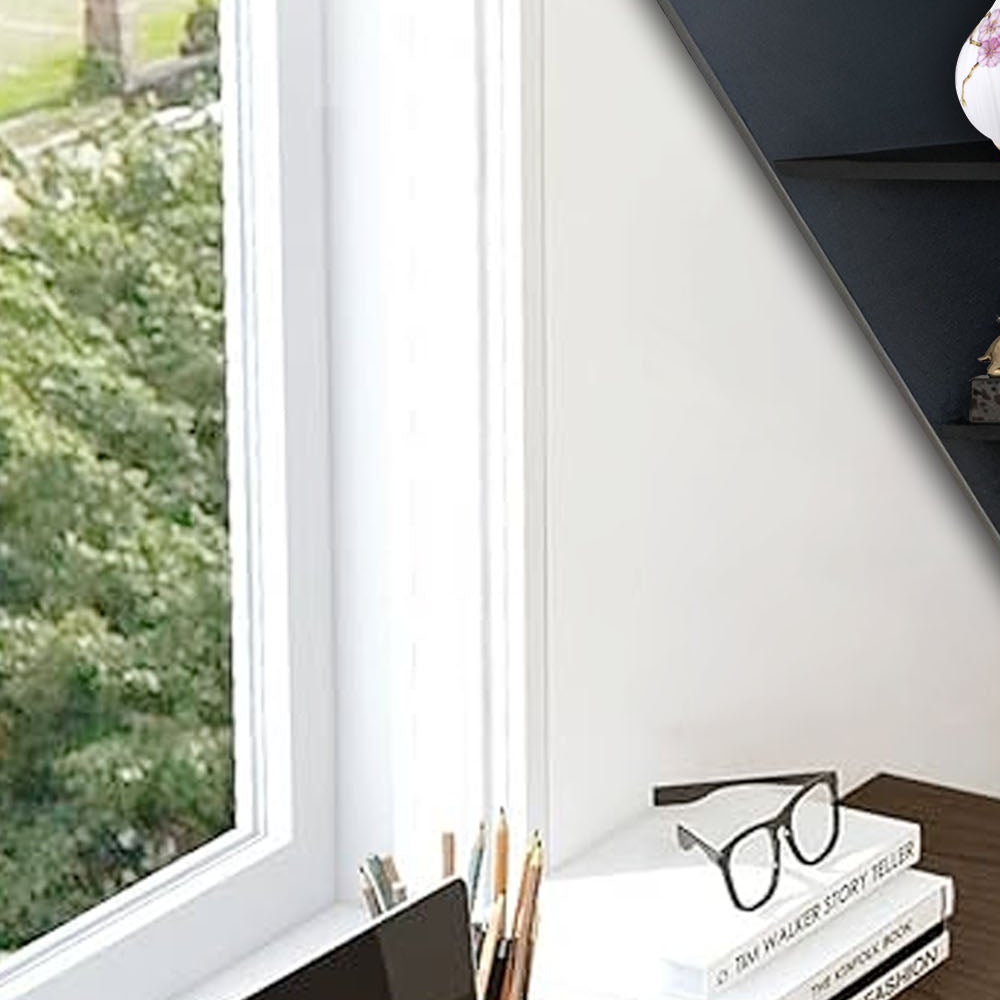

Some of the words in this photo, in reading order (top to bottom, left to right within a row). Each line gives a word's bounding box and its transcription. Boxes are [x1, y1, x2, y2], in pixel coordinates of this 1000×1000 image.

[735, 950, 760, 973] TIM
[763, 903, 820, 955] WALKER
[824, 871, 868, 914] STORY
[871, 840, 914, 882] TELLER
[811, 975, 831, 1000] THE
[883, 919, 912, 949] BOOK
